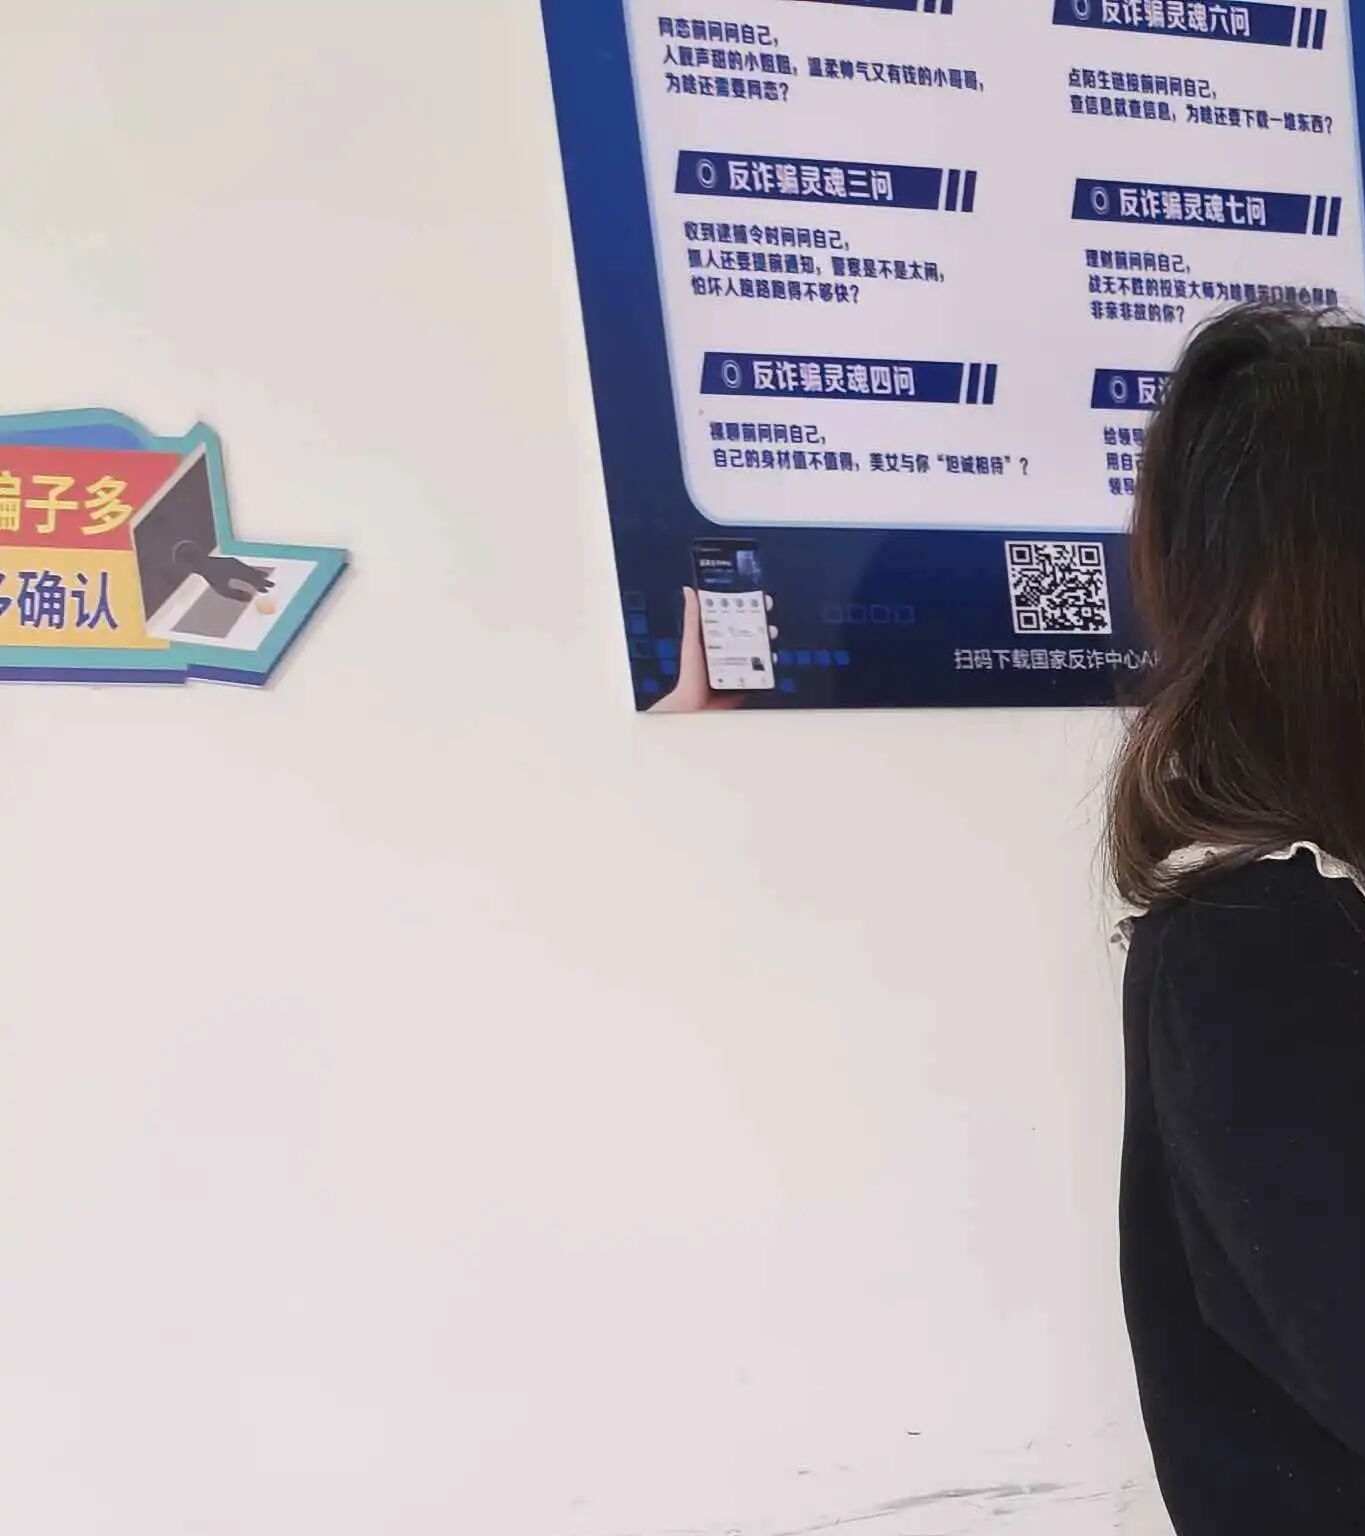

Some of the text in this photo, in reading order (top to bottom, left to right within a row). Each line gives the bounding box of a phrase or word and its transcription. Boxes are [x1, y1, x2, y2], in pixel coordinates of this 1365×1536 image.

[1101, 0, 1249, 37] 反诈骗灵魂六问
[1068, 68, 1217, 99] 点陌生链接前问问自己，
[727, 160, 894, 201] 反诈骗灵魂三问
[1119, 187, 1267, 226] 反诈骗灵魂七问
[752, 361, 916, 396] 反诈骗灵魂四问
[0, 570, 118, 629] 确认
